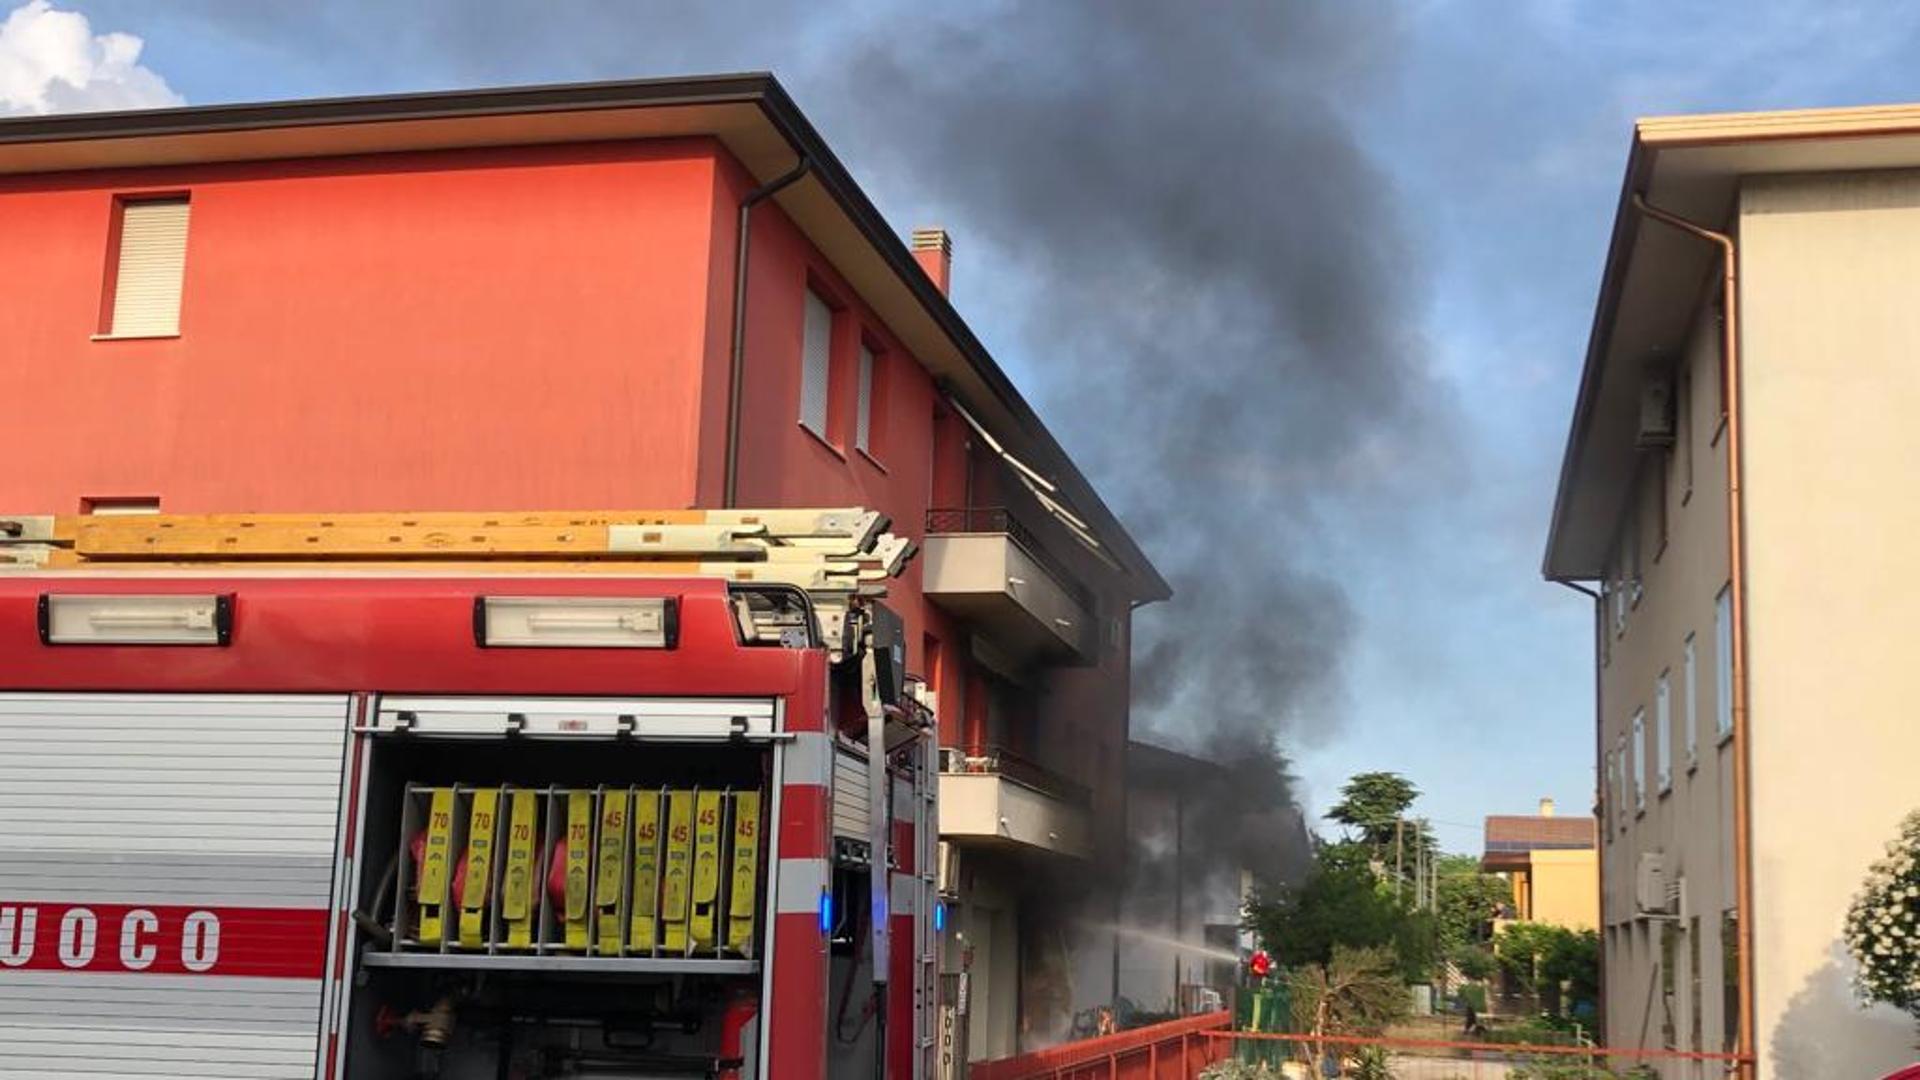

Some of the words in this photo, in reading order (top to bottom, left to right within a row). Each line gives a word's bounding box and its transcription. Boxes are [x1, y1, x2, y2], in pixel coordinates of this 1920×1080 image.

[433, 812, 449, 829] 70
[474, 813, 490, 830] 70
[605, 811, 622, 828] 45
[699, 809, 716, 826] 45
[514, 824, 529, 841] 70
[570, 824, 586, 840] 70
[639, 823, 655, 840] 45
[671, 825, 688, 842] 45
[738, 821, 754, 837] 45
[0, 907, 220, 972] UOCO
